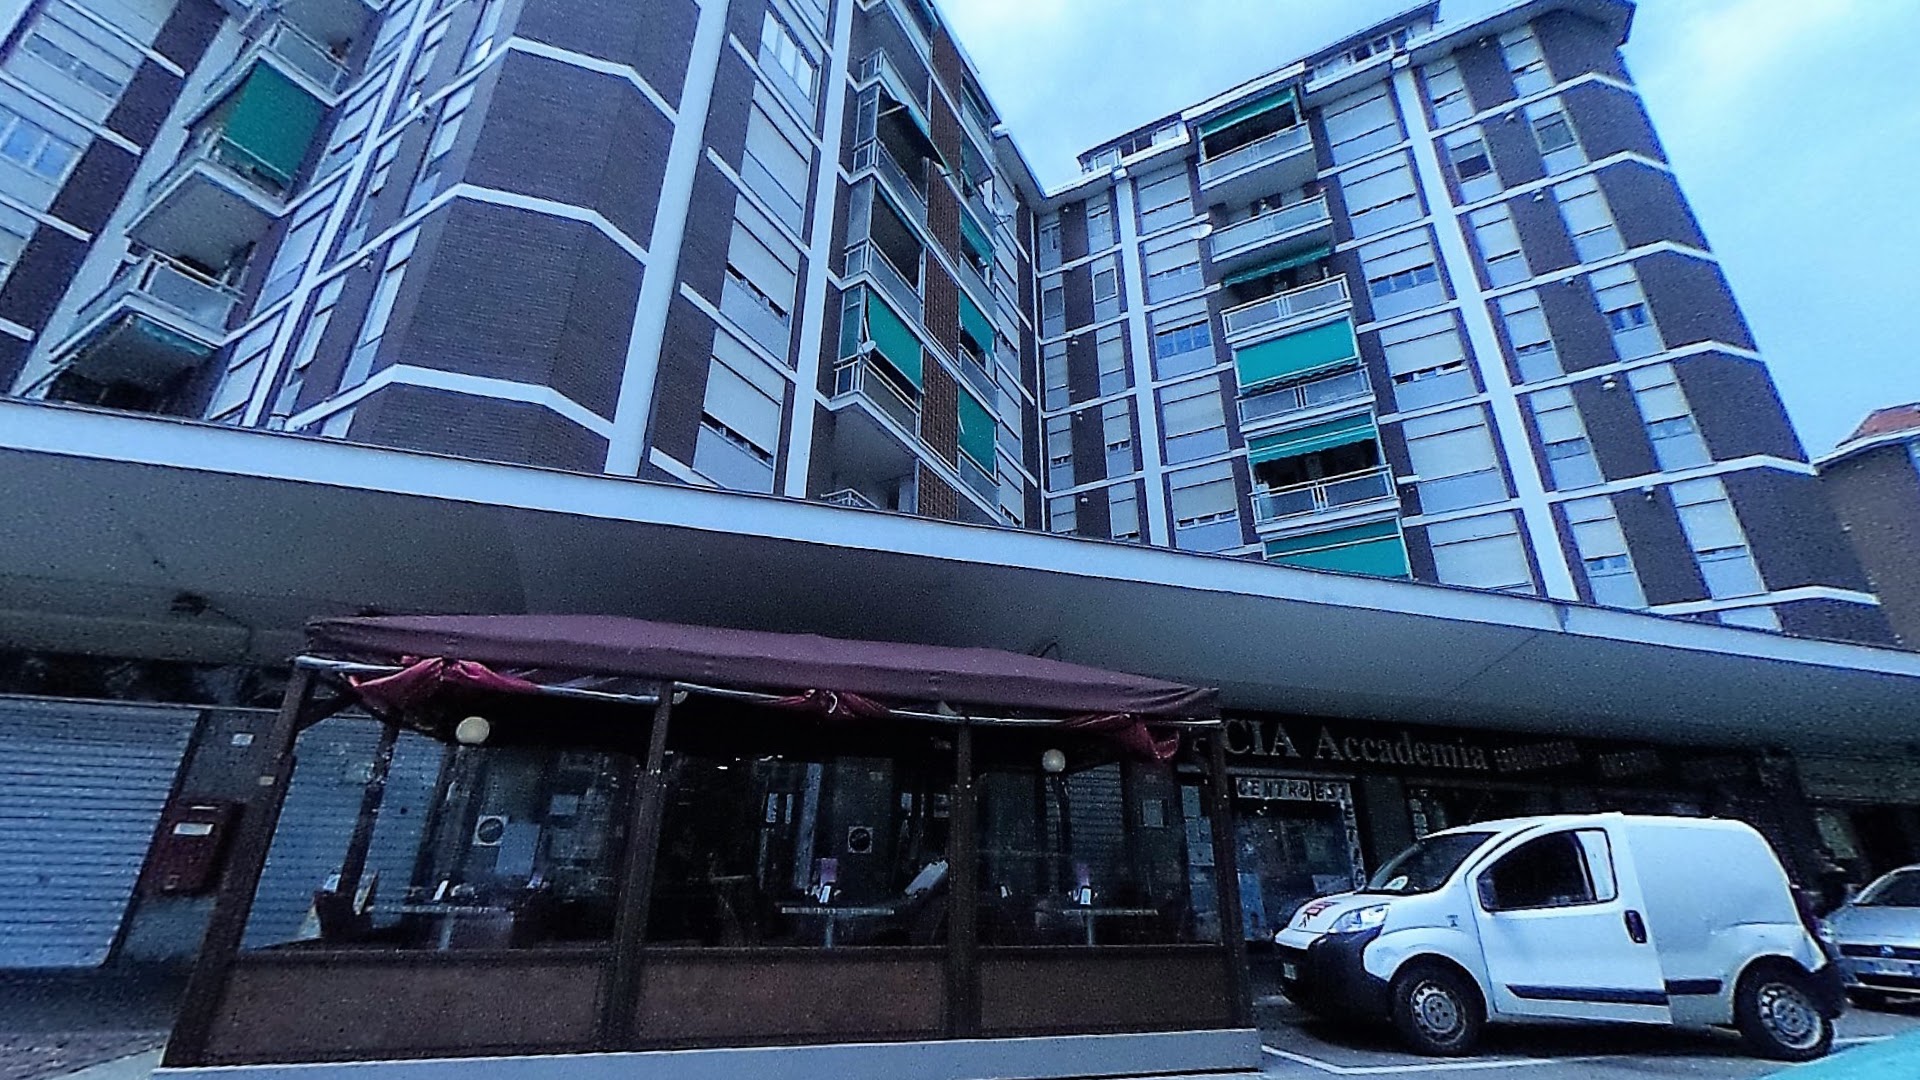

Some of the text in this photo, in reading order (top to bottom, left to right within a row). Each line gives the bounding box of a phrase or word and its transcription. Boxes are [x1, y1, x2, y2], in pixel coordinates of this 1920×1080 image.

[1192, 718, 1301, 758] CIA
[1313, 726, 1489, 770] Accademia
[1239, 780, 1310, 799] CENTRO
